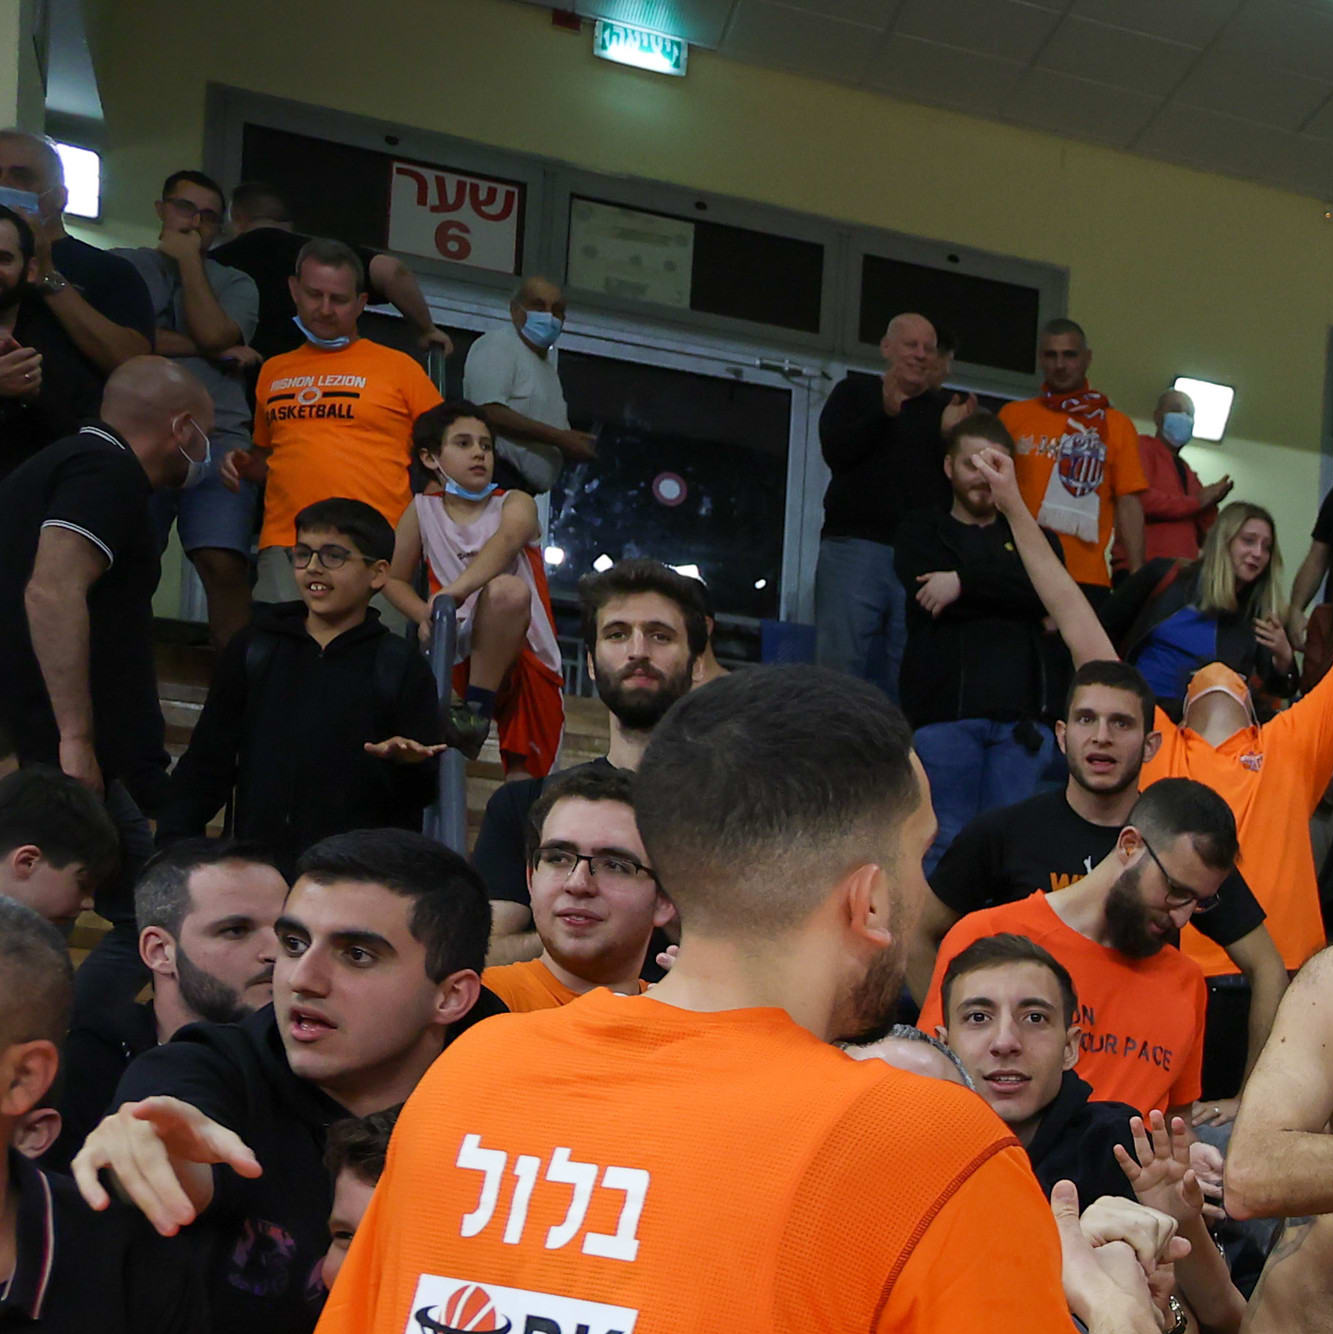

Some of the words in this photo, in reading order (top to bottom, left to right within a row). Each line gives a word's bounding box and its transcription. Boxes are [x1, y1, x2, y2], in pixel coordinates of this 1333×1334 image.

[395, 166, 516, 222] שער
[434, 220, 472, 261] 6
[318, 375, 366, 389] LEZION
[1123, 1035, 1172, 1072] PACE
[456, 1134, 650, 1261] בלול
